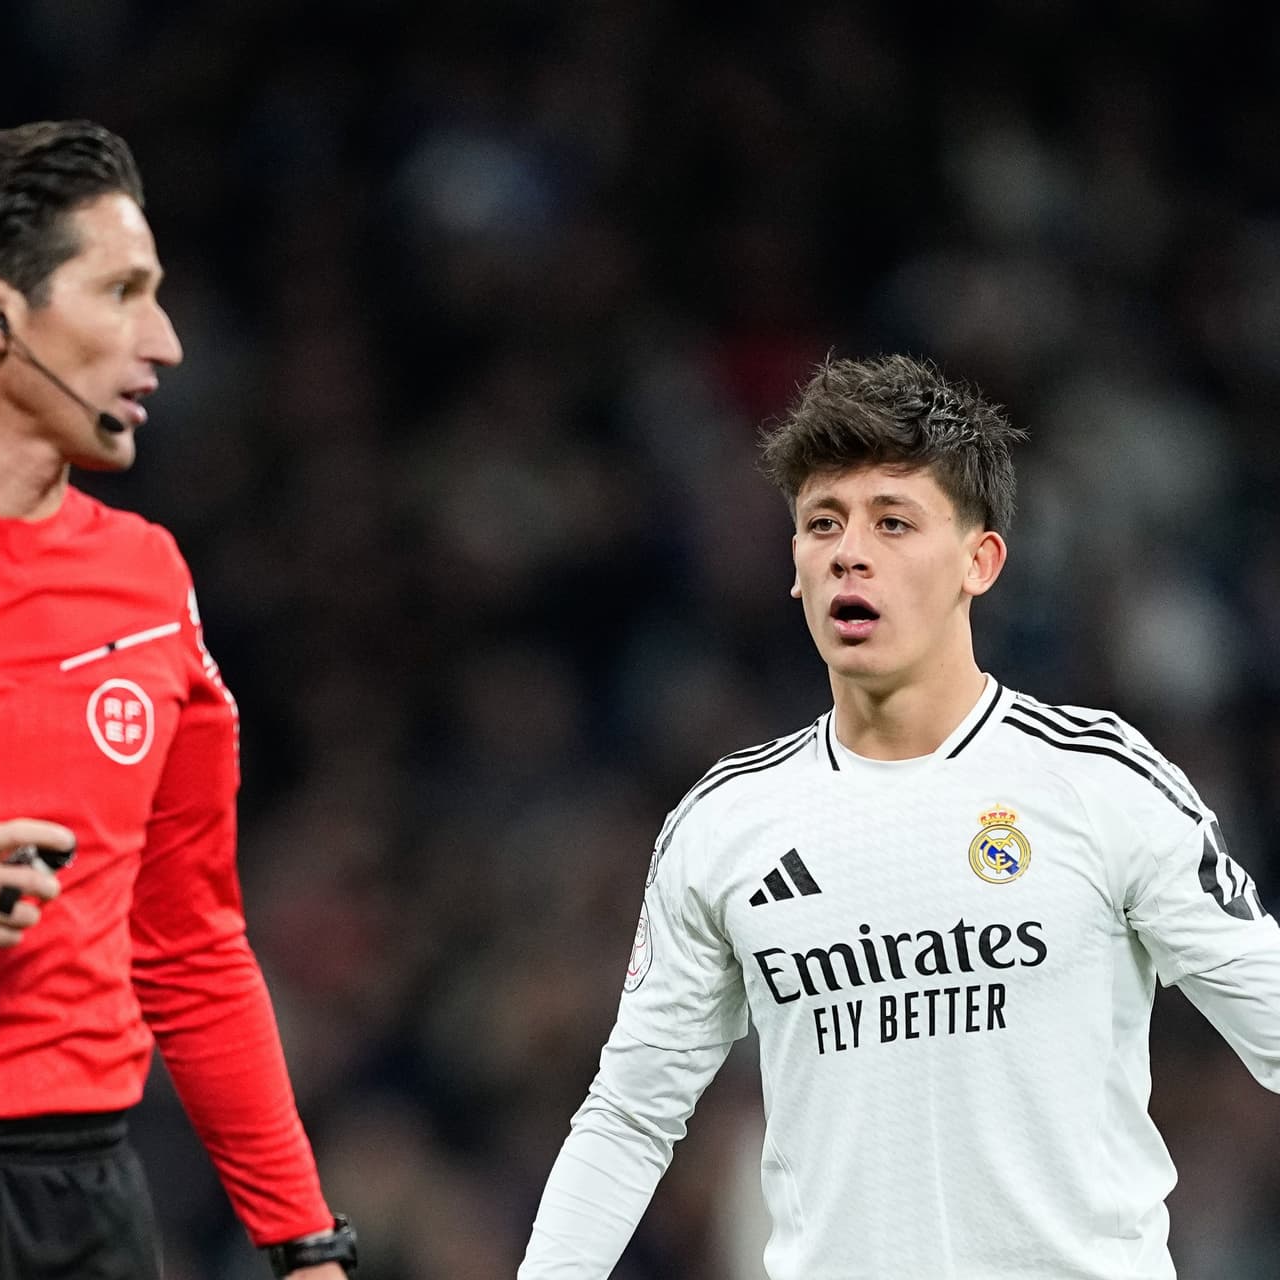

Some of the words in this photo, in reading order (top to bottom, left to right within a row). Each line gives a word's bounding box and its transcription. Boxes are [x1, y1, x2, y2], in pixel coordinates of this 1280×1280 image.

[752, 917, 1048, 1005] Emirates
[814, 999, 863, 1055] FLY
[880, 982, 1007, 1044] BETTER
